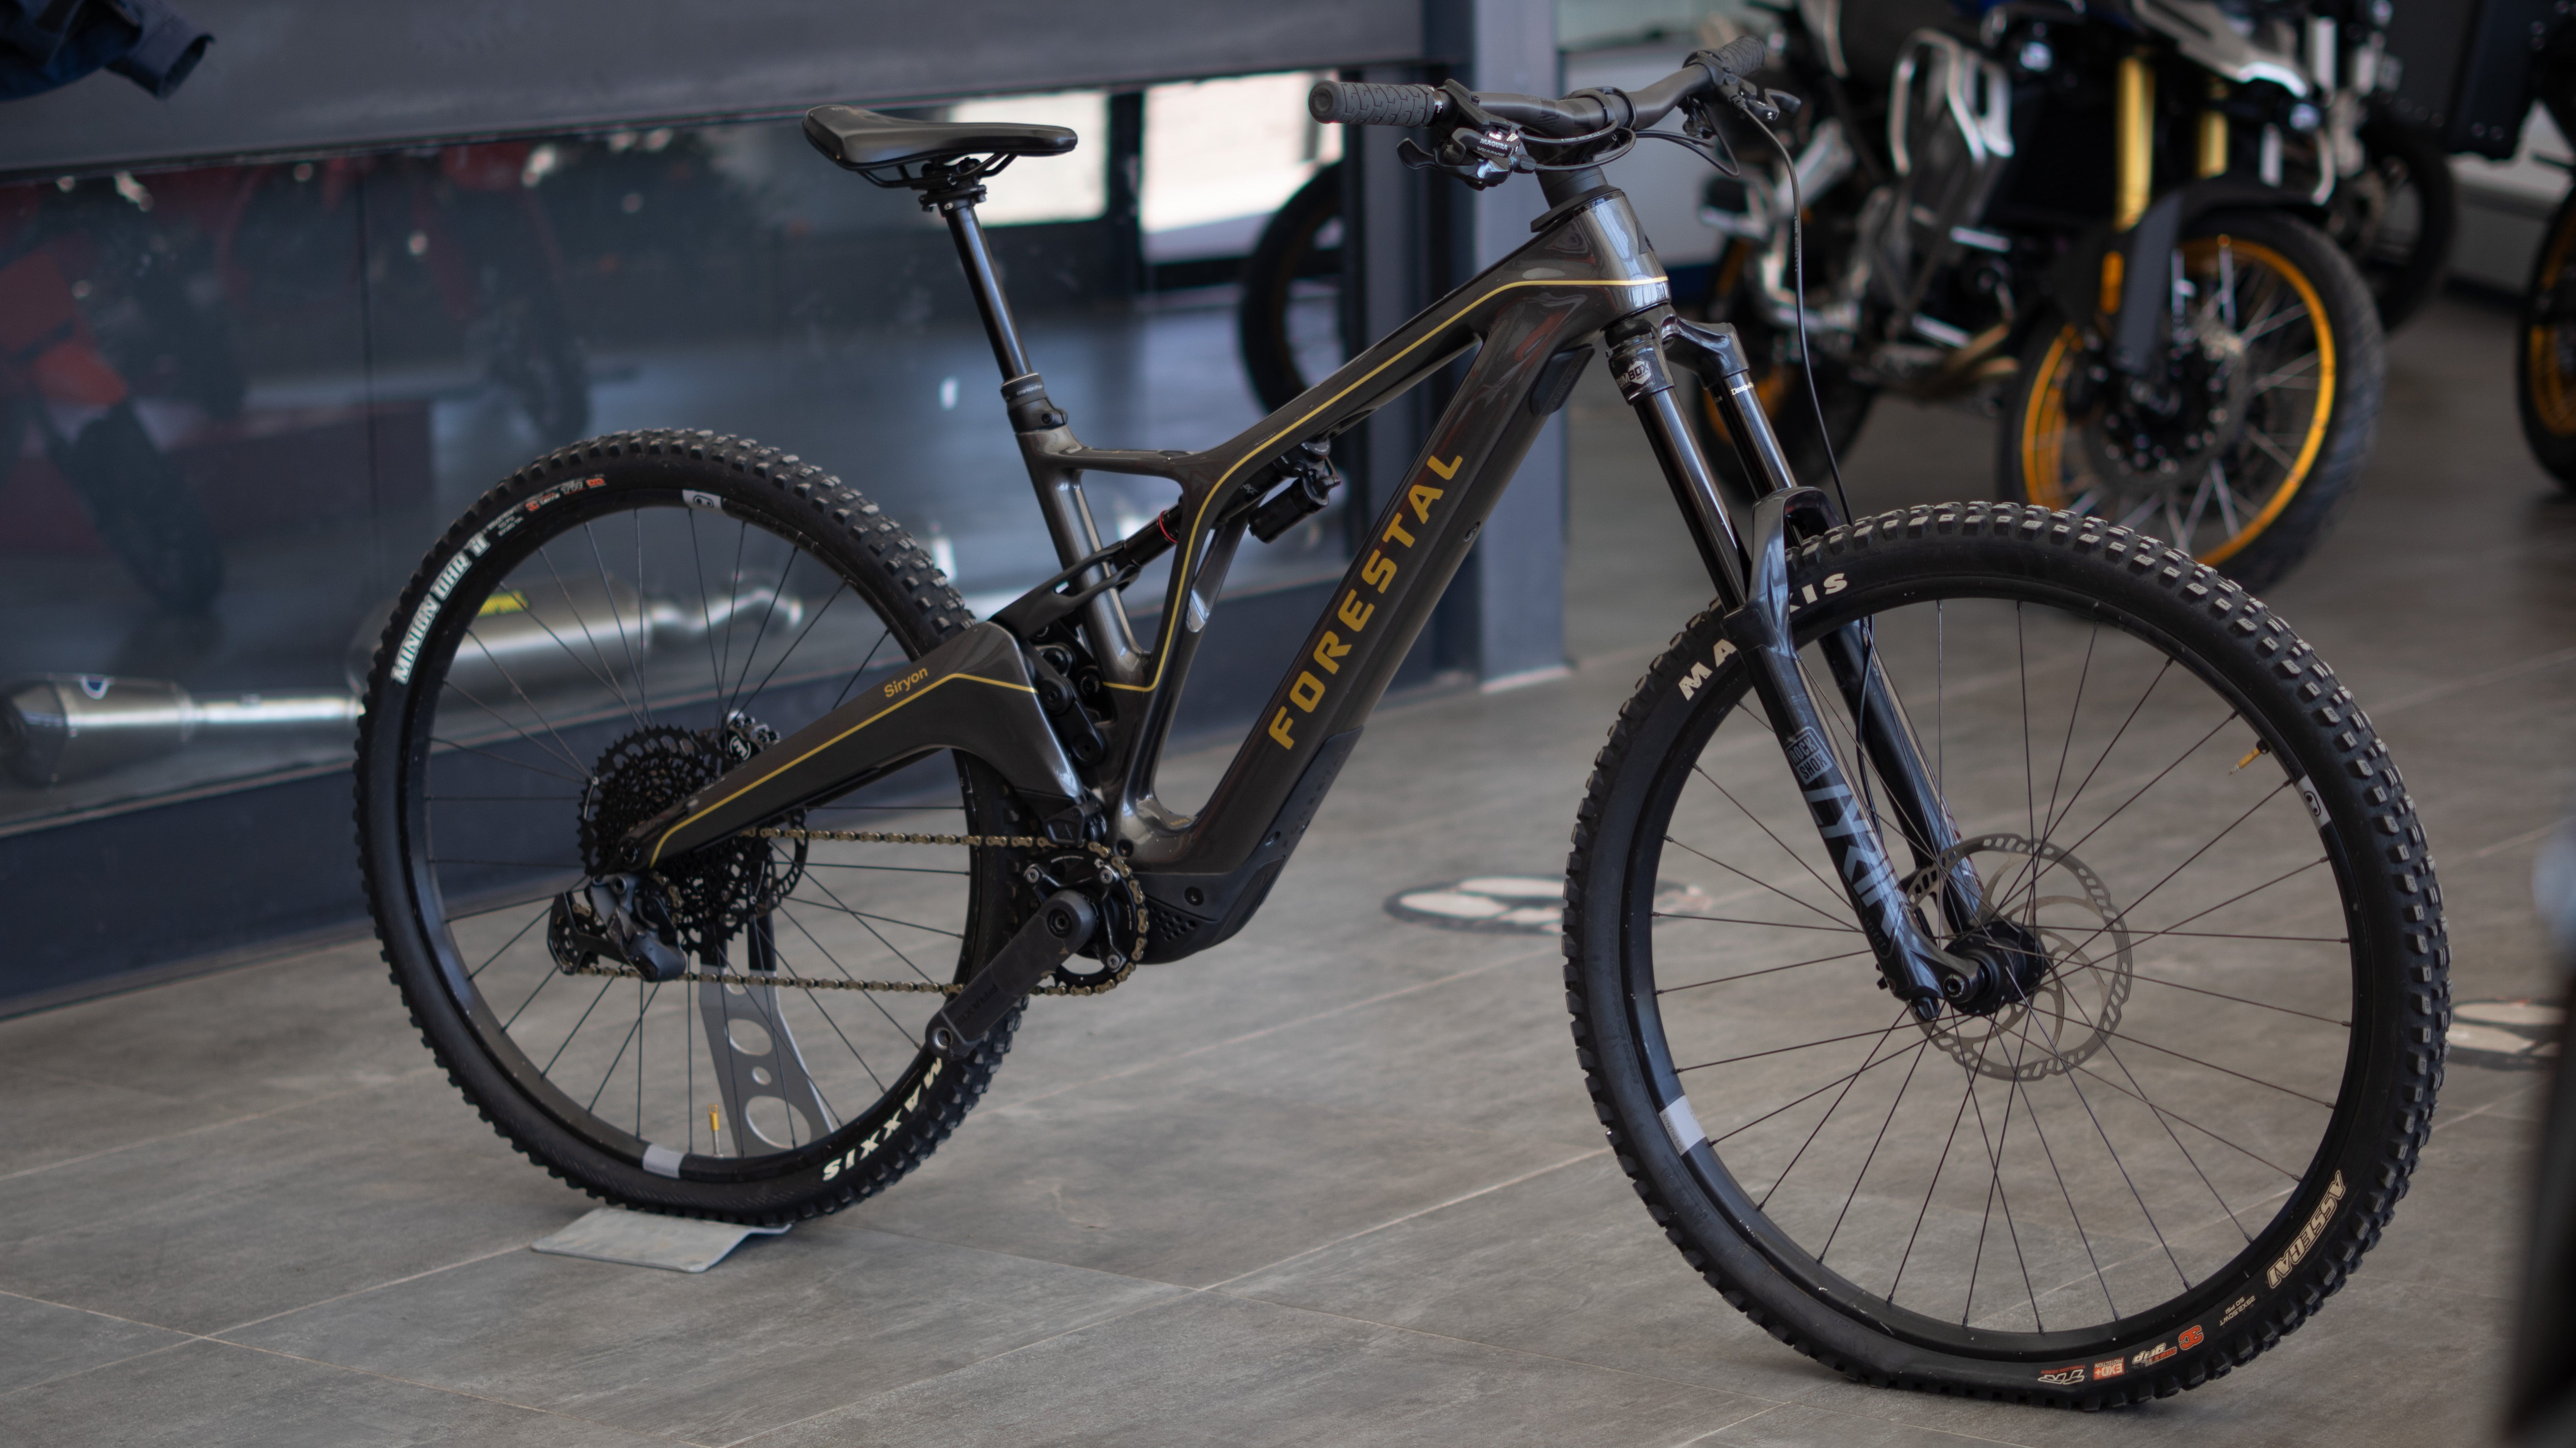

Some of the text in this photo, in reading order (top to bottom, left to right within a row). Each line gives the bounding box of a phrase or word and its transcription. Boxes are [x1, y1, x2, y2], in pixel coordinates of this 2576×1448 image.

[1479, 138, 1508, 150] MAGURA
[1268, 455, 1463, 750] FORESTAL
[390, 593, 441, 685] MINION
[429, 550, 472, 601] DHR
[884, 668, 928, 698] Siryon
[1789, 737, 1817, 764] ROCK
[1800, 753, 1827, 779] SHOX
[1864, 917, 1886, 948] SELECT
[822, 1057, 943, 1181] MAXXIS
[1662, 1114, 1683, 1151] SYNTHESIS
[2267, 1170, 2346, 1288] ASSEGAI
[2220, 1295, 2256, 1326] 29X2.50WT
[2225, 1304, 2235, 1314] PSI
[2178, 1325, 2204, 1350] 3C
[2095, 1358, 2123, 1367] PROTECTION
[2132, 1342, 2166, 1364] grip
[2059, 1364, 2086, 1372] TUBELESS
[2095, 1363, 2123, 1376] EXO+
